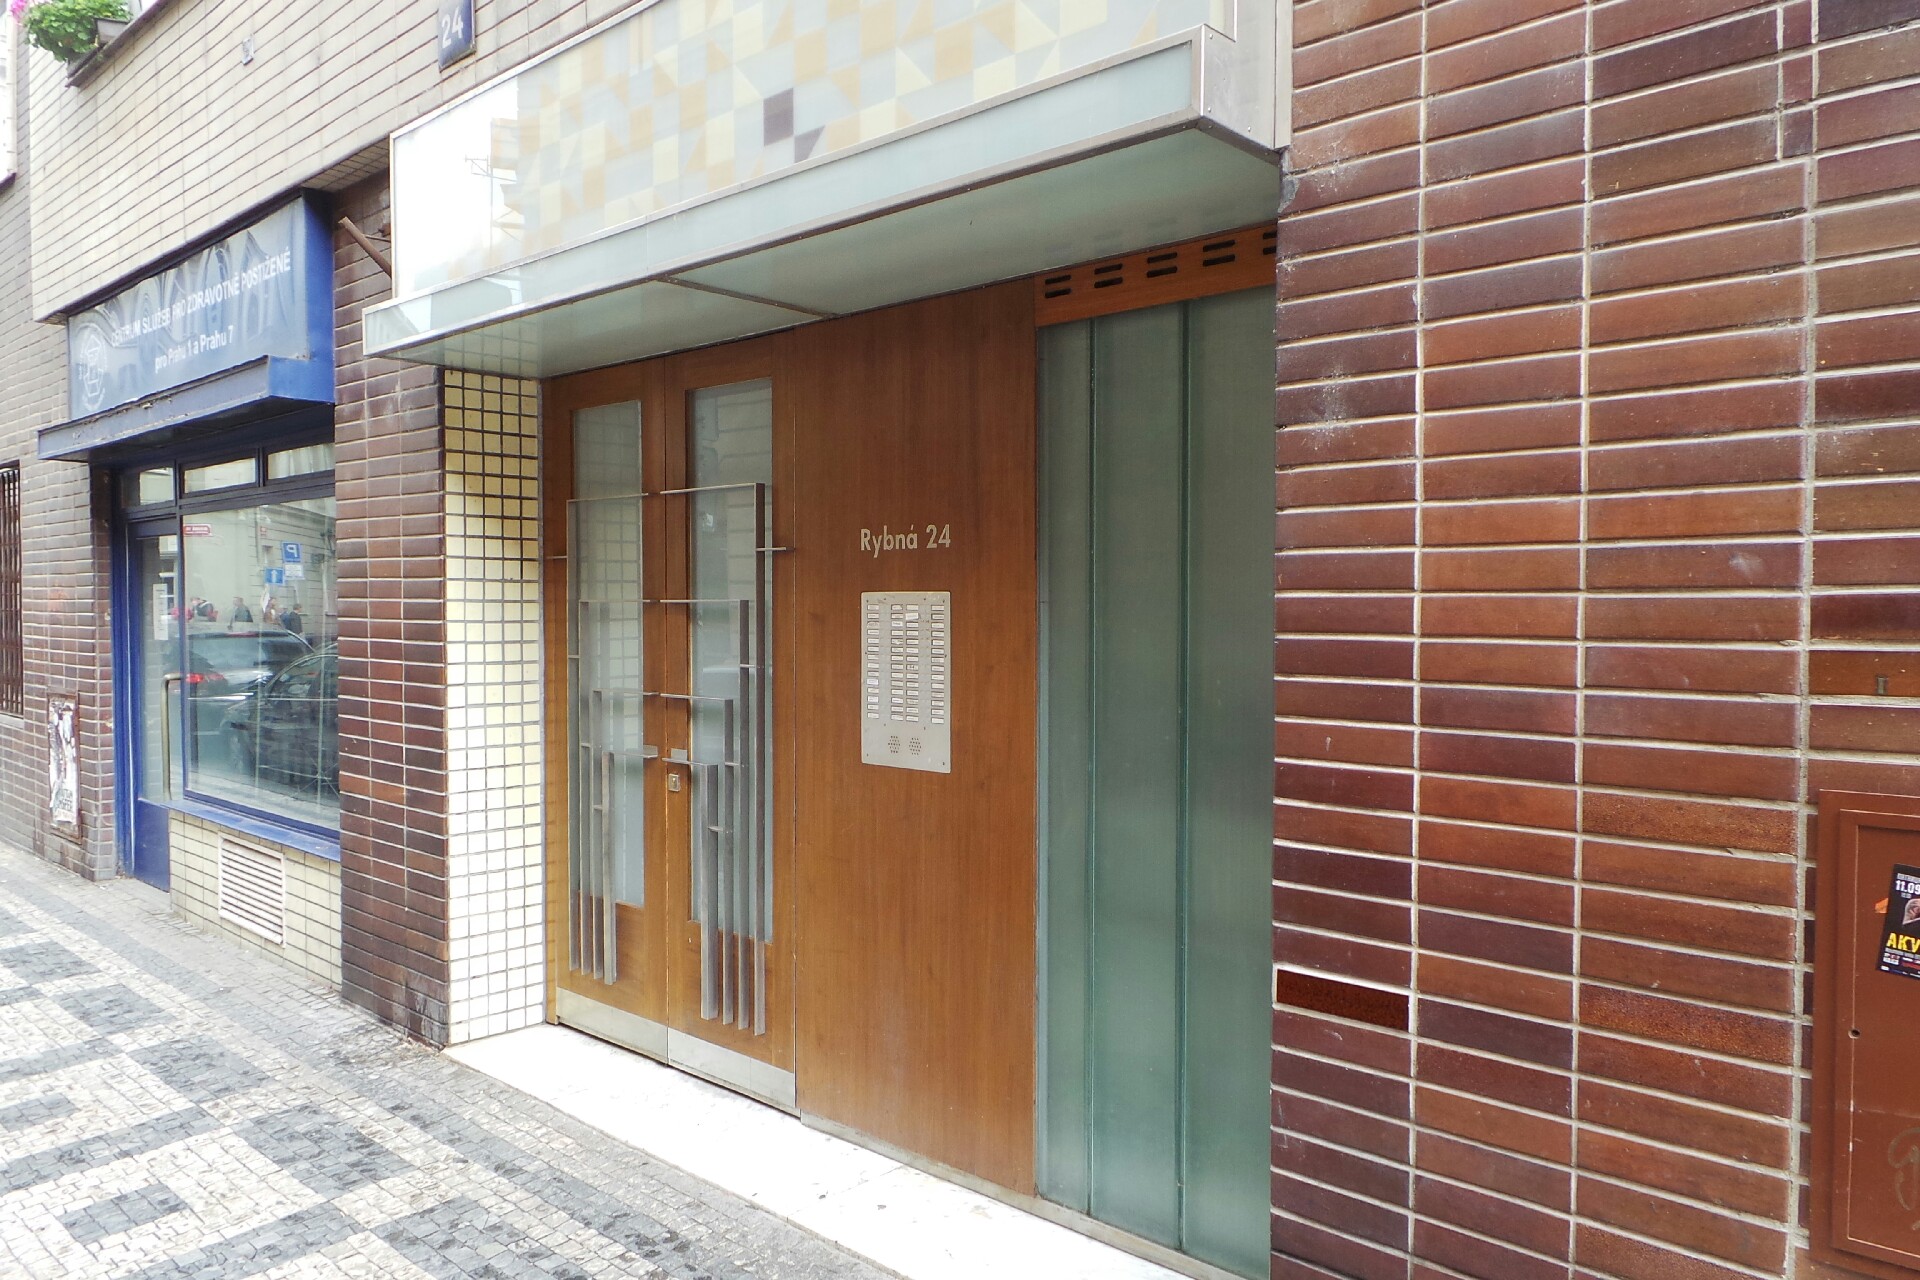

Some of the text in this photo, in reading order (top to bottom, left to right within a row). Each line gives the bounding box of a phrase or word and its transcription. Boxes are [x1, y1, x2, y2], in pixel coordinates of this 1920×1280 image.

[441, 6, 464, 49] 24
[172, 299, 186, 320] PRO
[155, 354, 168, 374] pro
[168, 344, 186, 366] Prahu
[193, 340, 199, 355] a
[200, 329, 228, 352] Prahu
[228, 324, 234, 344] 7
[860, 523, 952, 558] Rybná 24
